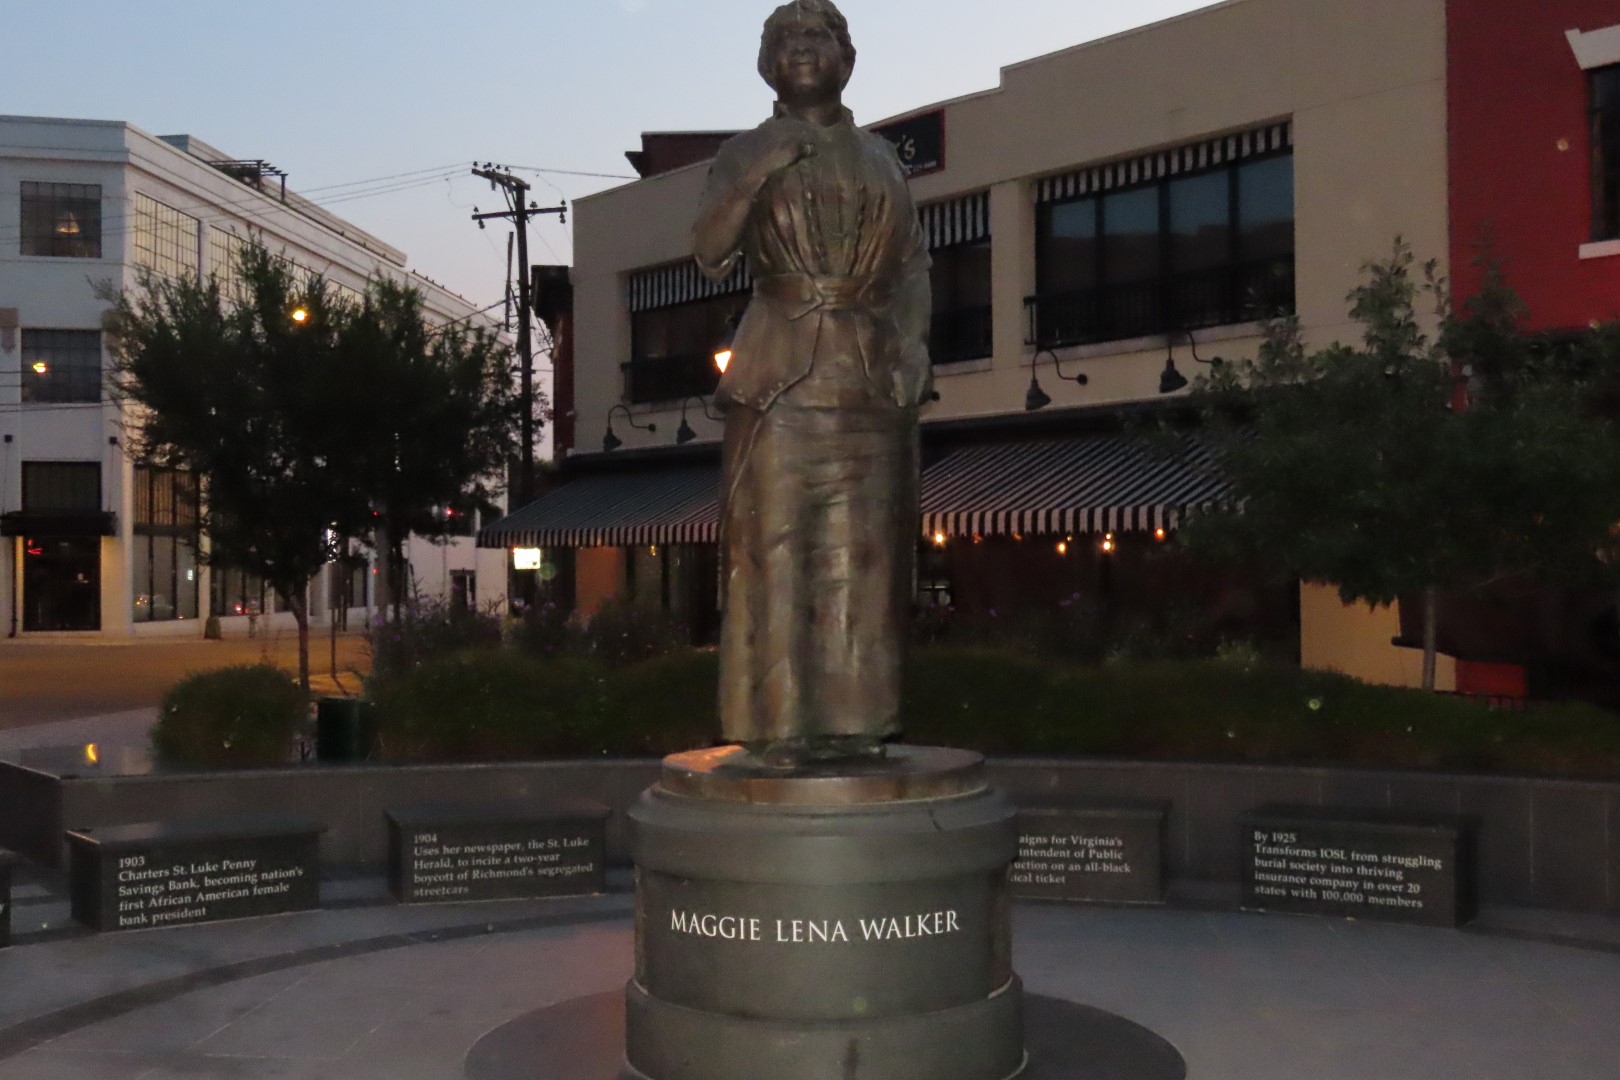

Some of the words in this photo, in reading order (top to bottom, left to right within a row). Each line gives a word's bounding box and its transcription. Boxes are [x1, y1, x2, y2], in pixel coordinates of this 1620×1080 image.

[414, 834, 437, 843] 1904
[1019, 835, 1047, 846] aigns
[1051, 835, 1066, 845] for
[1071, 835, 1122, 847] Virginia's
[1254, 831, 1268, 842] By
[1272, 832, 1296, 842] 1925
[414, 847, 439, 856] Uses
[443, 845, 460, 854] her
[464, 842, 524, 854] newspaper,
[528, 840, 544, 849] the
[547, 839, 560, 848] St.
[563, 838, 589, 847] Luke
[1019, 848, 1070, 858] intendent
[1074, 850, 1084, 858] of
[1089, 849, 1123, 859] Public
[1255, 843, 1316, 857] Transforms
[1320, 848, 1347, 860] IOSL
[1351, 851, 1378, 862] from
[1382, 855, 1442, 869] struggling
[119, 856, 145, 868] 1903
[414, 859, 454, 869] Herald,
[458, 858, 468, 866] to
[472, 855, 501, 865] incite
[505, 856, 510, 864] a
[514, 853, 560, 863] two-year
[1014, 861, 1047, 869] uction
[1051, 862, 1064, 870] on
[1085, 862, 1131, 873] all-black
[1255, 858, 1286, 868] burial
[1290, 861, 1326, 873] society
[1331, 863, 1352, 873] into
[1357, 865, 1403, 880] thriving
[119, 868, 169, 882] Charters
[173, 866, 188, 876] St.
[191, 862, 218, 874] Luke
[223, 859, 256, 871] Penny
[414, 872, 453, 884] boycott
[457, 870, 468, 880] of
[472, 868, 533, 879] Richmond's
[538, 863, 592, 876] segregated
[1011, 873, 1032, 882] ical
[1036, 874, 1065, 884] ticket
[119, 883, 164, 896] Savings
[204, 872, 257, 886] becoming
[262, 867, 303, 880] nation's
[1255, 872, 1306, 883] insurance
[1310, 877, 1359, 890] company
[1363, 880, 1374, 889] in
[1378, 883, 1403, 892] over
[1408, 883, 1420, 893] 20
[119, 899, 143, 911] first
[148, 892, 191, 908] African
[196, 888, 249, 902] American
[253, 882, 289, 895] female
[414, 886, 469, 896] streetcars
[1255, 885, 1286, 895] states
[1291, 888, 1316, 899] with
[1368, 896, 1423, 908] members
[119, 914, 148, 926] bank
[152, 907, 206, 923] president
[671, 909, 760, 940] MAGGIE
[776, 920, 848, 942] LENA
[860, 910, 959, 941] WALKER
